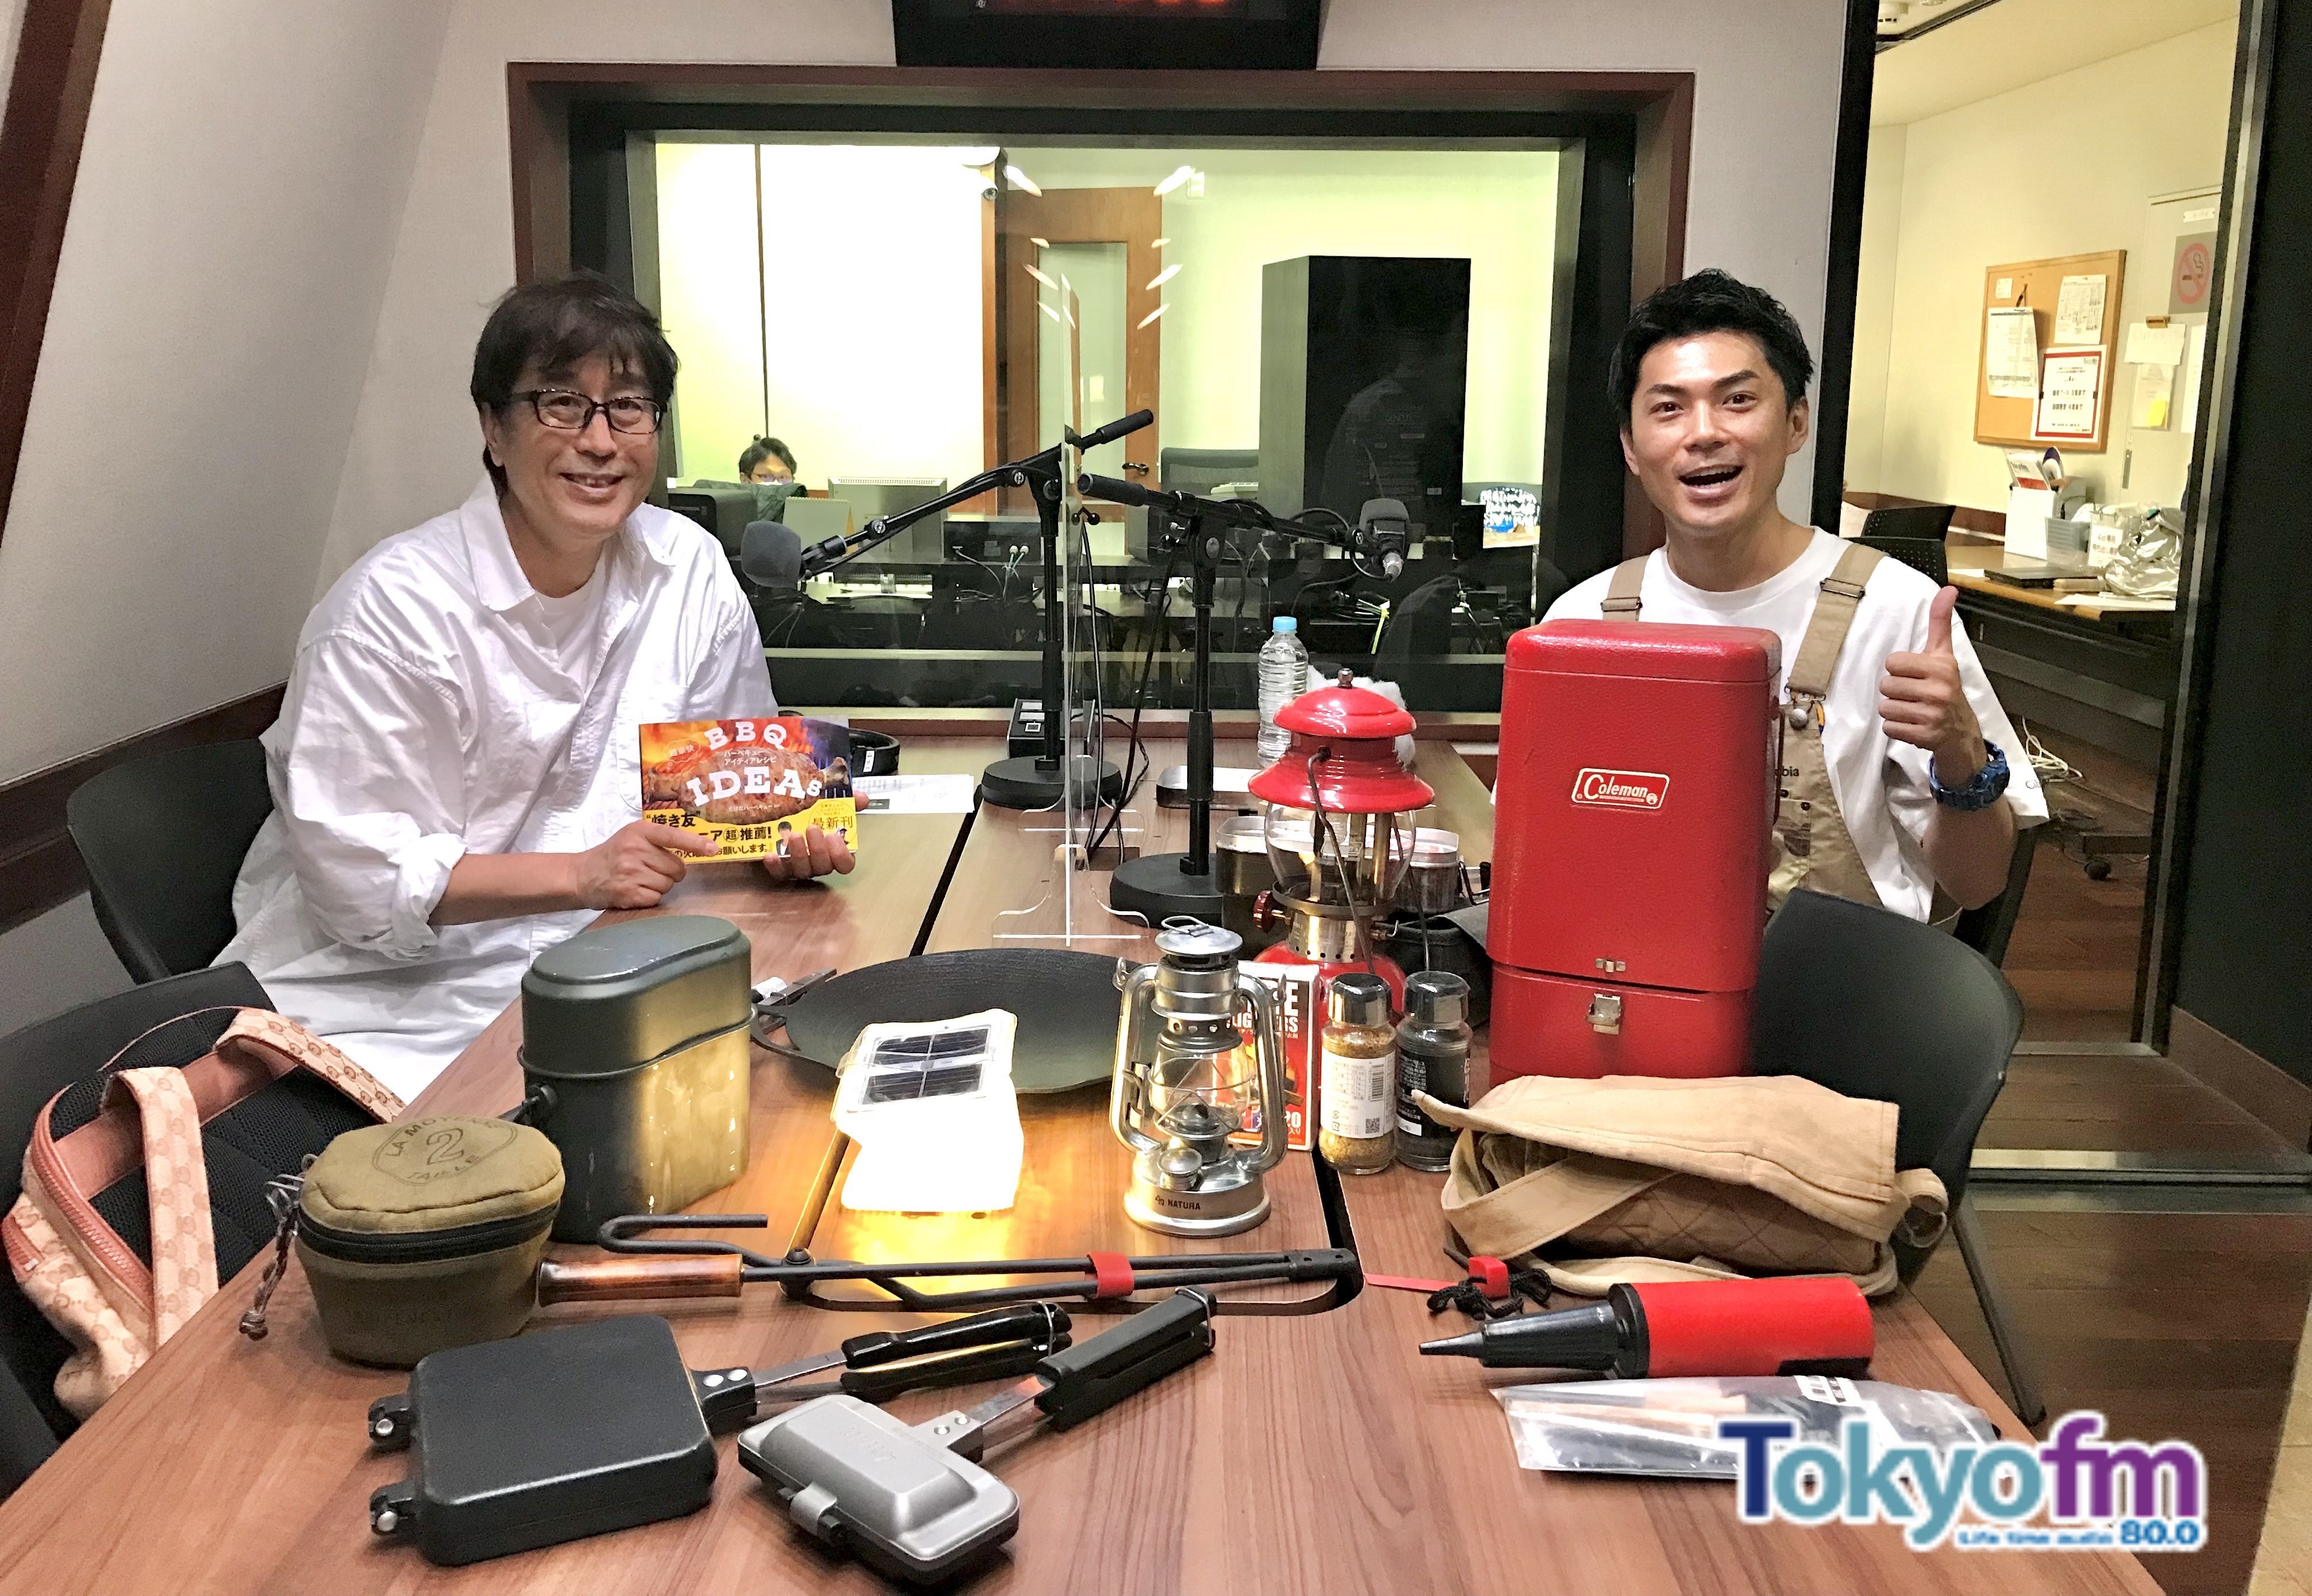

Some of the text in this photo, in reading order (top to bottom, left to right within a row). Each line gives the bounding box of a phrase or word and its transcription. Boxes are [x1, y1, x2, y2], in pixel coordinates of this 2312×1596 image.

[704, 721, 787, 750] BBQ
[724, 748, 763, 757] バーベキュー
[1774, 765, 1799, 777] bia
[1584, 774, 1648, 800] Coleman
[1284, 1111, 1302, 1128] 20
[385, 1140, 409, 1157] LA
[425, 1127, 464, 1166] 2
[1167, 1198, 1201, 1210] NATURA
